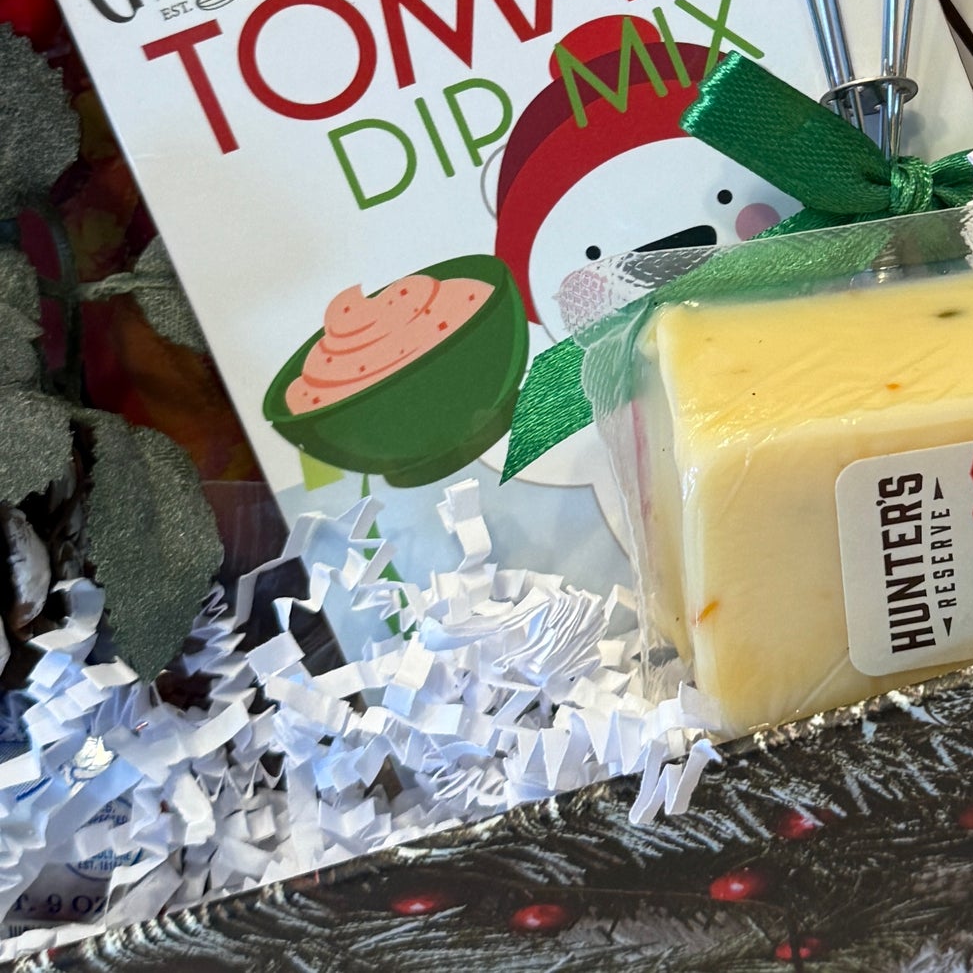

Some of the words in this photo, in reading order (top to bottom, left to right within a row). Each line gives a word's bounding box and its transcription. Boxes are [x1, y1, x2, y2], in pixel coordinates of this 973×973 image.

[160, 0, 193, 21] EST.
[328, 78, 513, 211] DIP
[876, 473, 936, 654] HUNTER'S
[931, 509, 957, 608] RESERVE
[46, 893, 62, 915] 9
